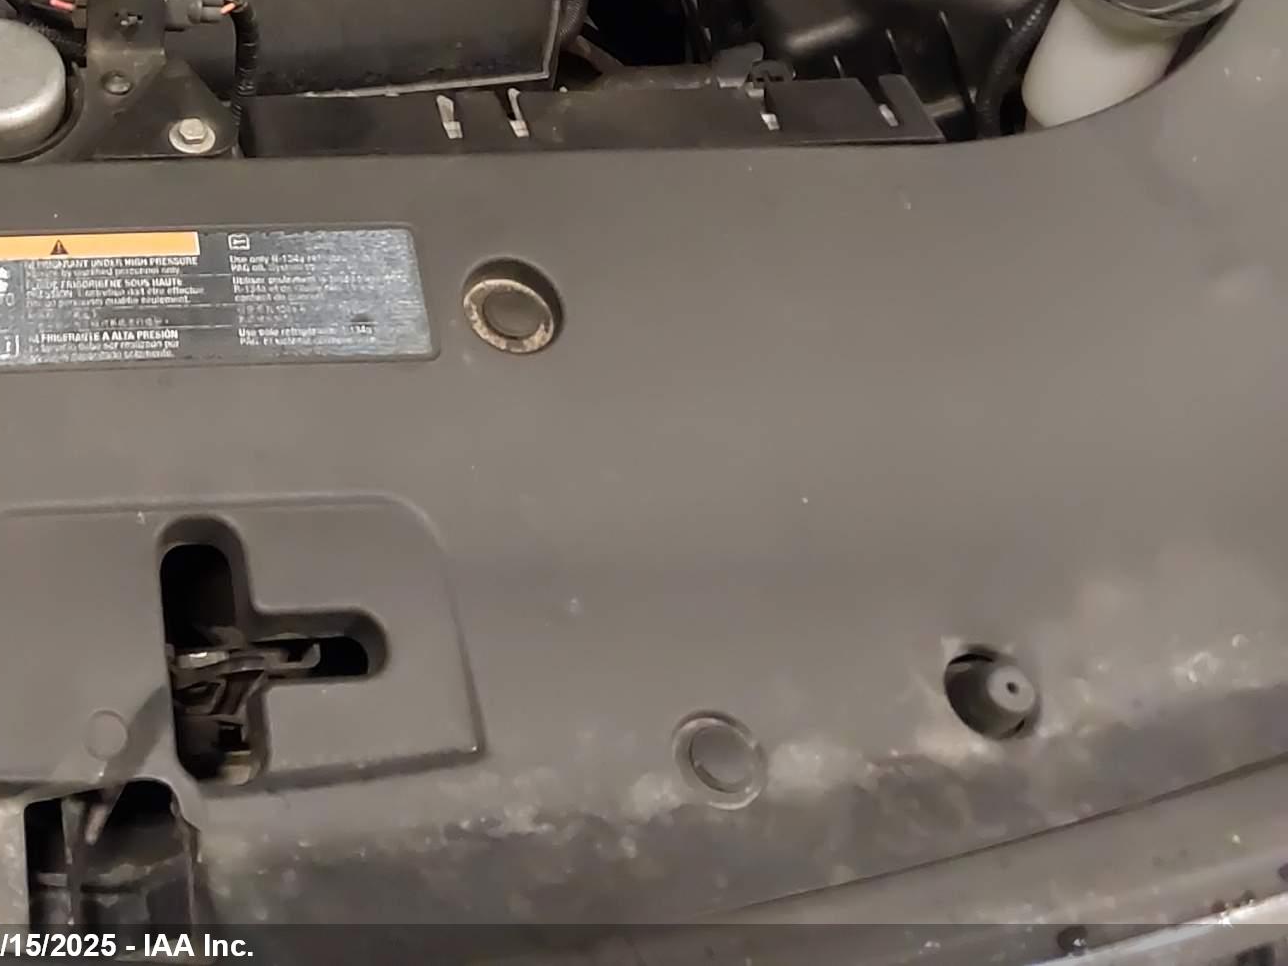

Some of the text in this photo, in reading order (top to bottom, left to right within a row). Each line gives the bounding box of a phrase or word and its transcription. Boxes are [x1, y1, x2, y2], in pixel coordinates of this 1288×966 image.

[149, 256, 199, 266] PRESSURE
[152, 276, 183, 287] HAUTE
[111, 329, 135, 341] ALTA
[136, 327, 179, 340] PRESIÓN
